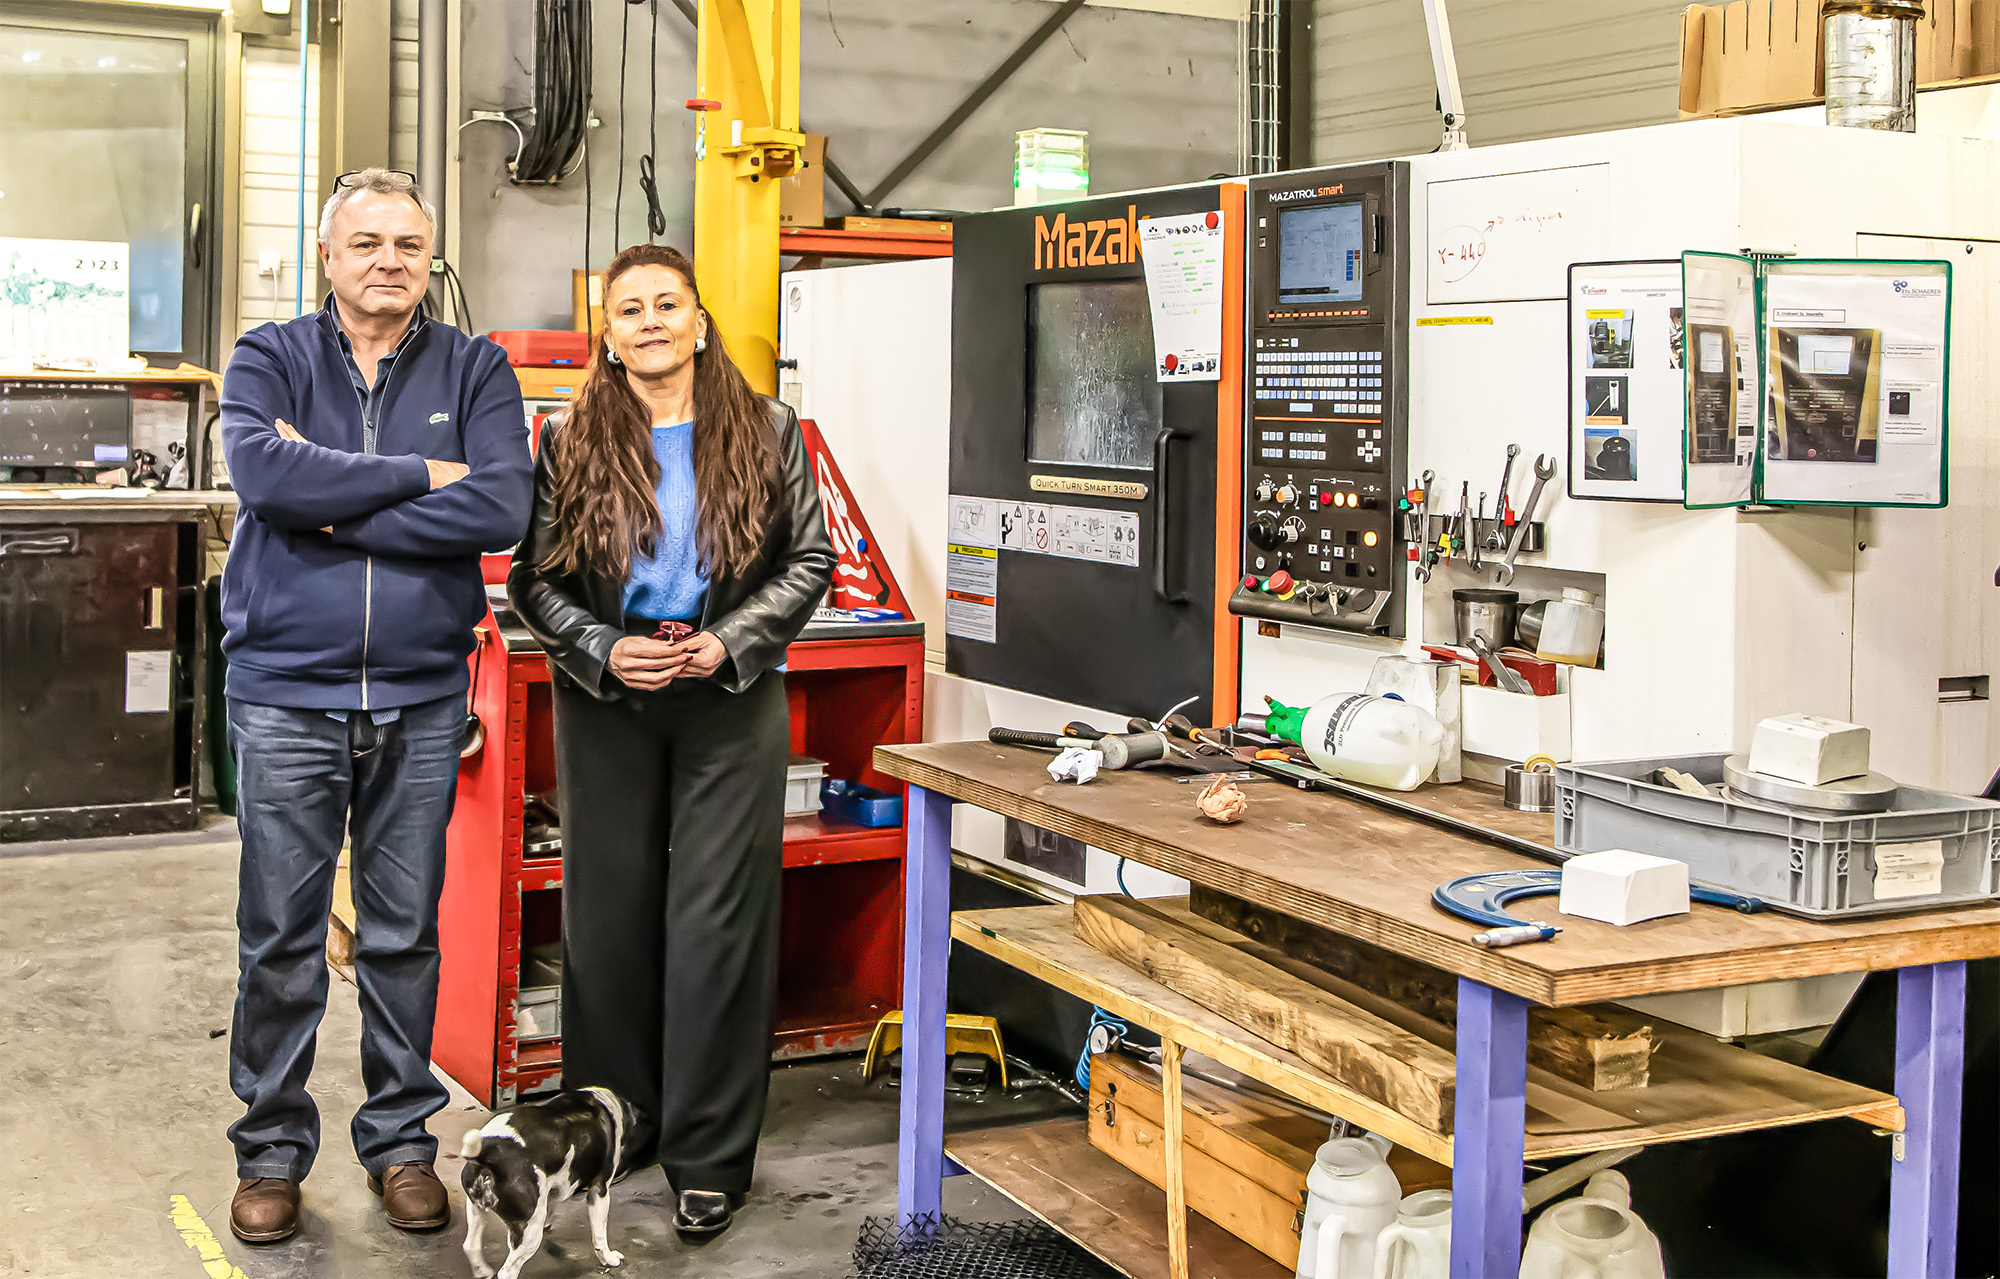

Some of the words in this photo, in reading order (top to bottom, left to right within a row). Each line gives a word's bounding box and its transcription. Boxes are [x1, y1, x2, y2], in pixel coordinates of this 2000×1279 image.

[1269, 189, 1317, 202] MAZATROL
[1318, 183, 1344, 197] smart
[1034, 204, 1151, 270] Mazak
[1036, 478, 1059, 489] QUICK
[1061, 480, 1082, 491] TURN
[1084, 482, 1111, 493] SMART
[1113, 485, 1138, 495] 350M
